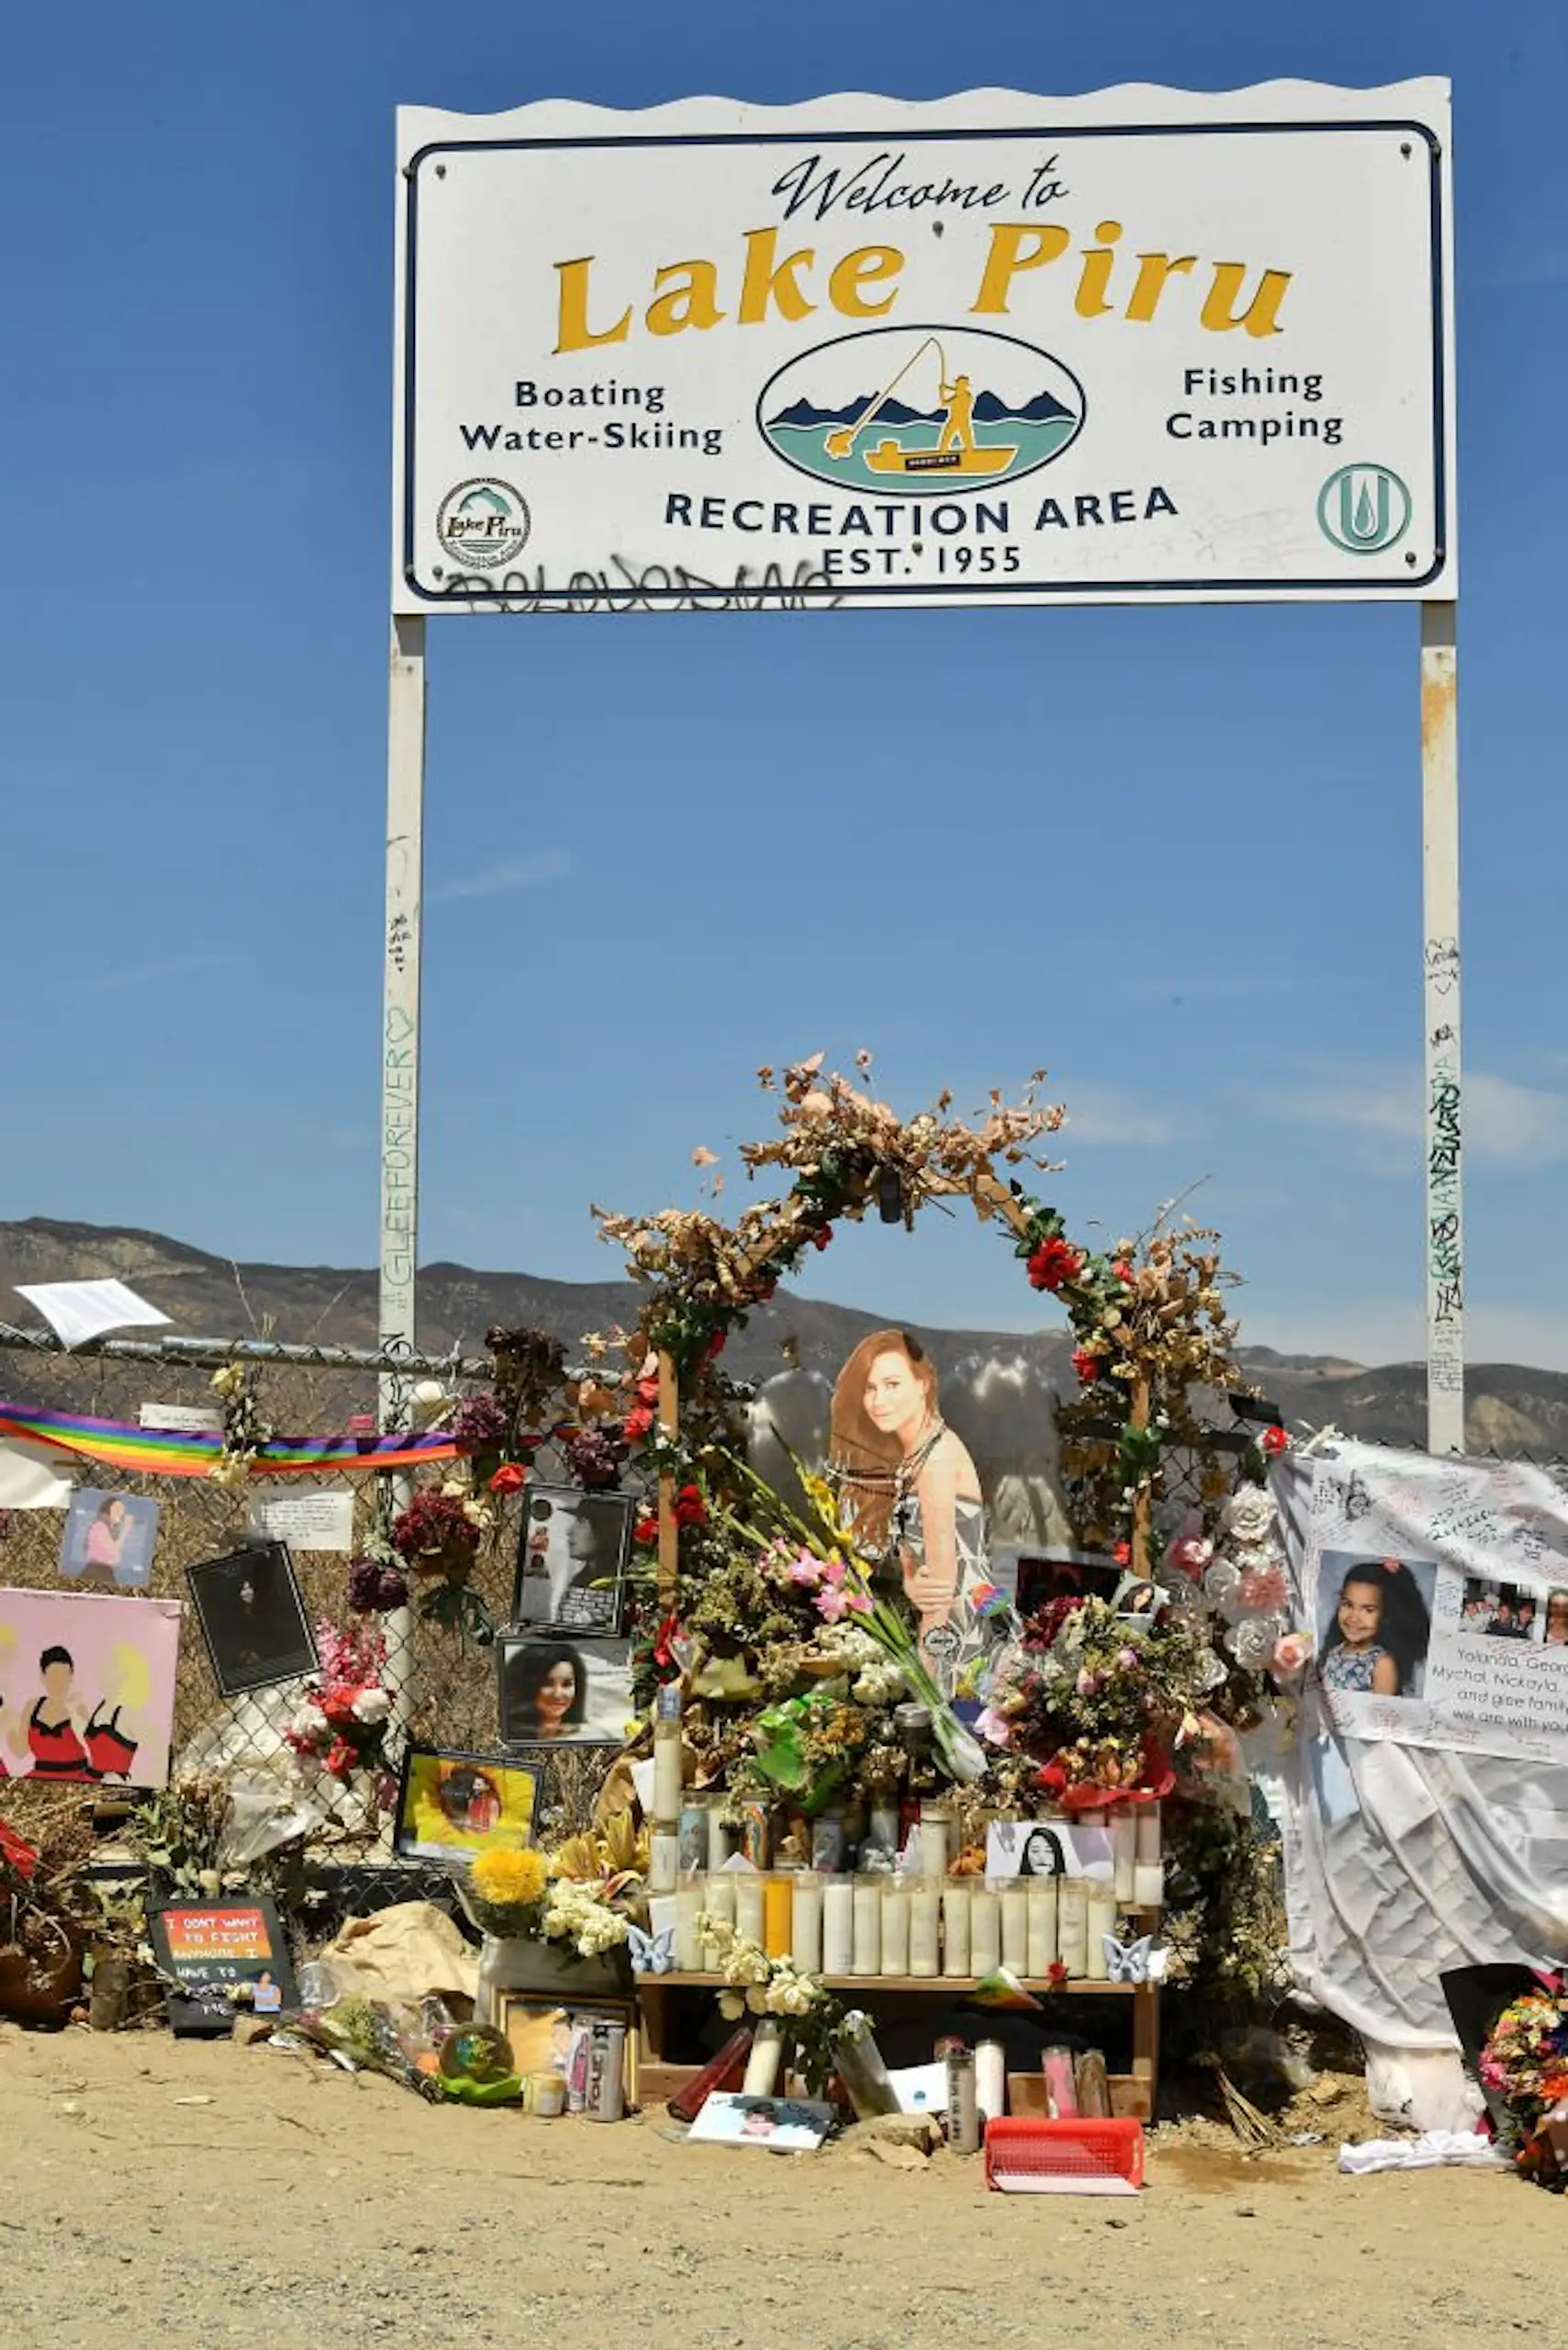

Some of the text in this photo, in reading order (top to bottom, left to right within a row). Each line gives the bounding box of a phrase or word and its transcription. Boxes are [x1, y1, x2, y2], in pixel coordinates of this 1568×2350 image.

[772, 153, 1069, 220] Welcome to
[552, 220, 1293, 354] Lake Piru
[515, 379, 665, 413] Boating
[1183, 367, 1323, 402] Fishing
[459, 421, 723, 455] Water-Skiing
[1166, 411, 1344, 446] Camping
[666, 486, 1179, 536] RECREATION AREA
[938, 546, 1021, 574] 1955
